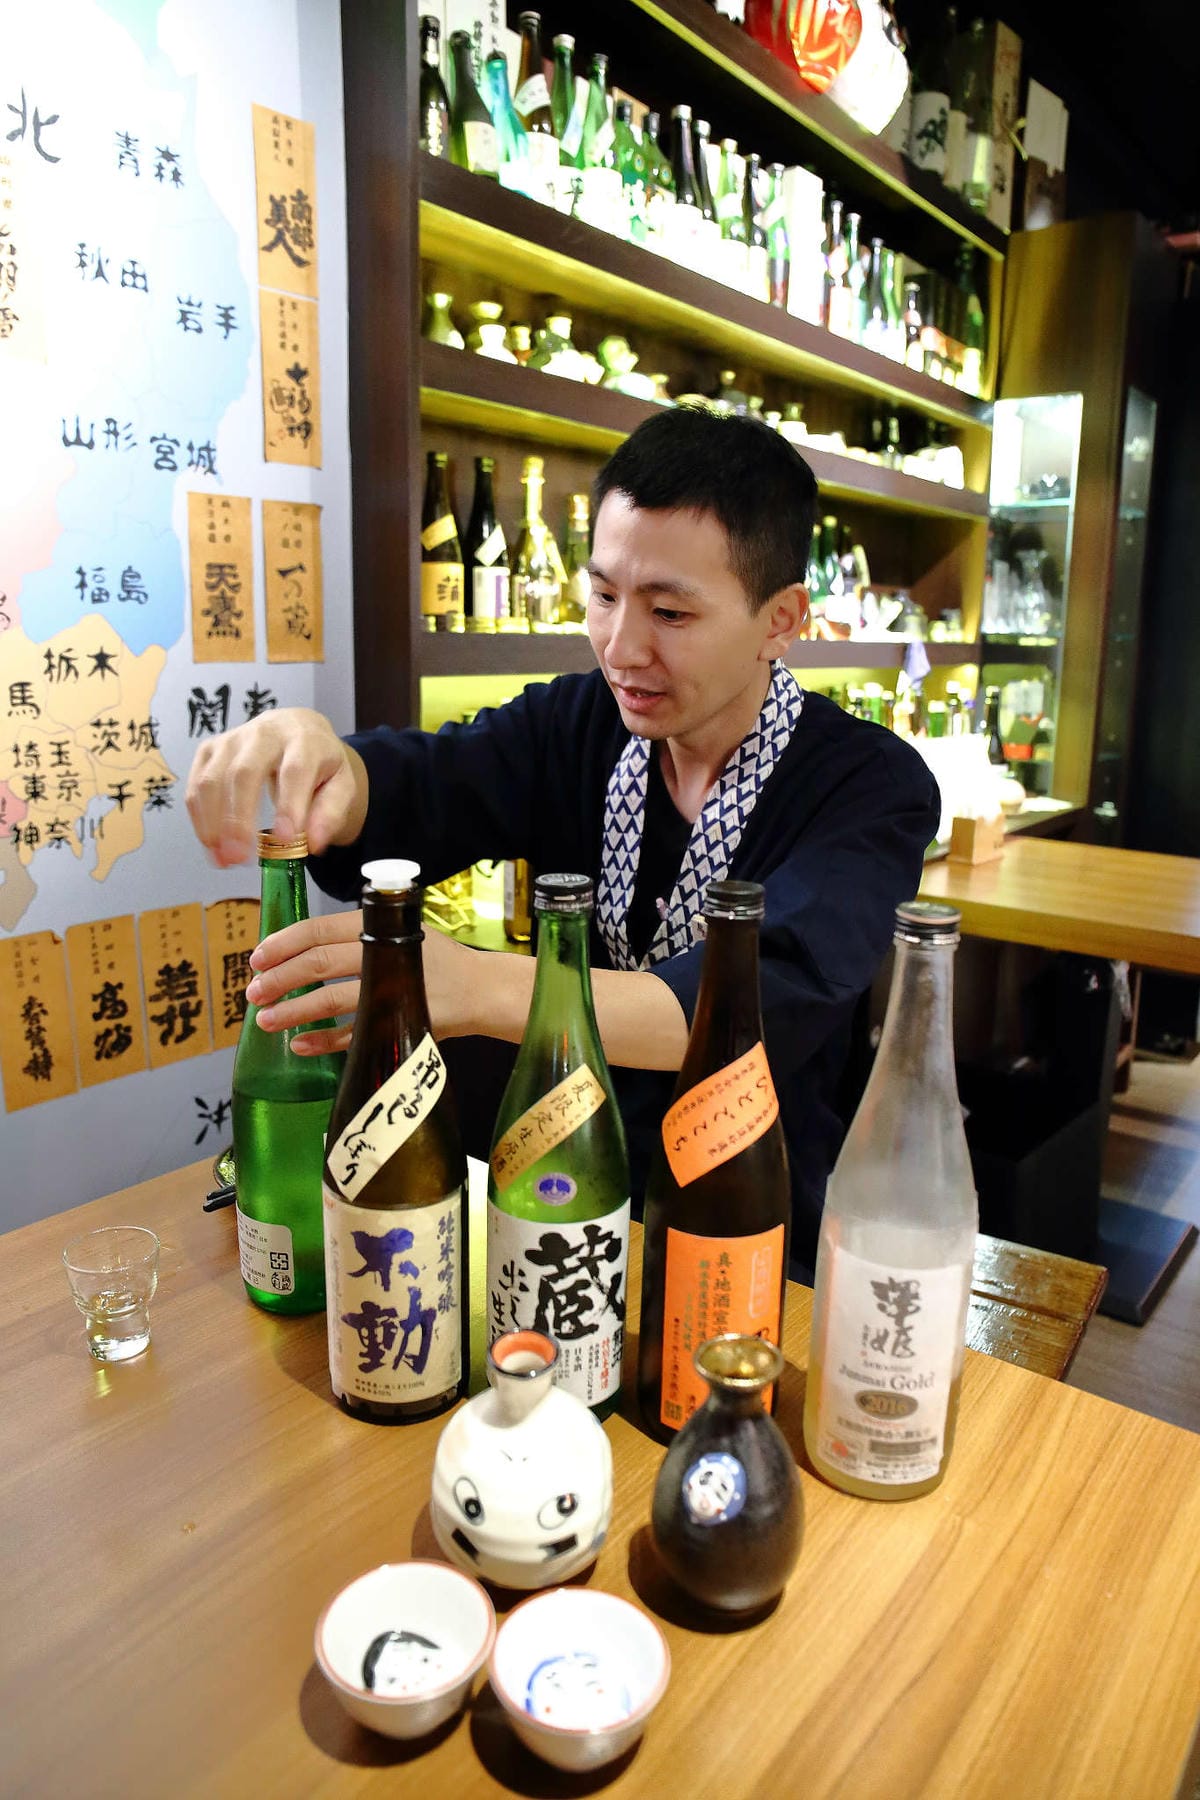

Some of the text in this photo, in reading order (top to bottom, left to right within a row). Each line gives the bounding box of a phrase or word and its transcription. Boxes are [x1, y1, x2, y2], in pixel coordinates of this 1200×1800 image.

[114, 131, 185, 189] 青森
[74, 242, 150, 293] 秋田
[176, 296, 239, 339] 岩手
[62, 415, 138, 452] 山形
[150, 433, 217, 475] 宮城
[75, 565, 149, 605] 福島
[44, 646, 119, 682] 栃木
[13, 740, 73, 769] 埼玉
[90, 717, 161, 755] 茨城
[23, 770, 82, 802] 東京
[107, 777, 174, 812] 千葉
[10, 816, 105, 852] 神奈川
[341, 1227, 437, 1375] 不動
[890, 1371, 936, 1392] Gold
